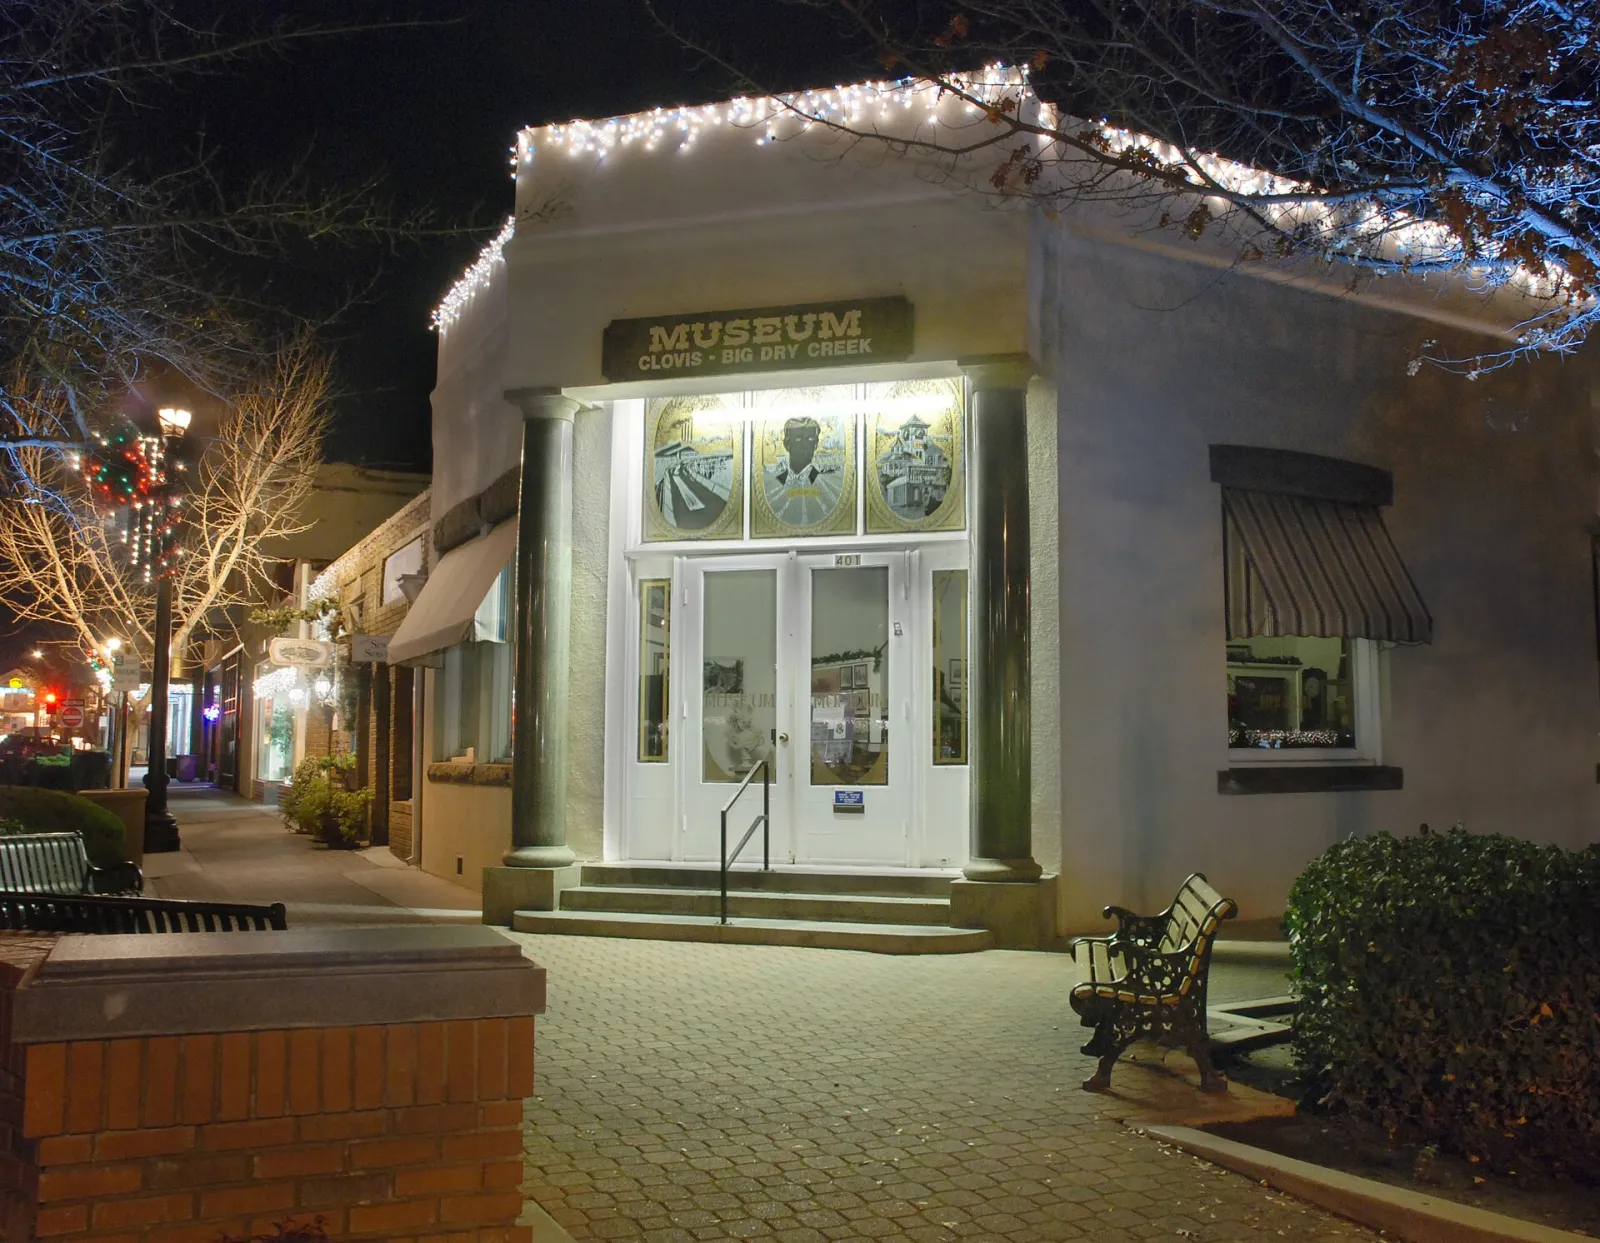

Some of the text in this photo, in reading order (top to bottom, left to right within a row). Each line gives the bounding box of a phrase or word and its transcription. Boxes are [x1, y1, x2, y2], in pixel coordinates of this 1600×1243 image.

[648, 309, 863, 353] MUSEUM
[638, 351, 703, 371] CLOVIS
[722, 347, 753, 365] BIG
[760, 343, 799, 361] DRY
[807, 338, 873, 358] CREEK
[836, 555, 859, 566] 401
[814, 693, 888, 708] MUUM
